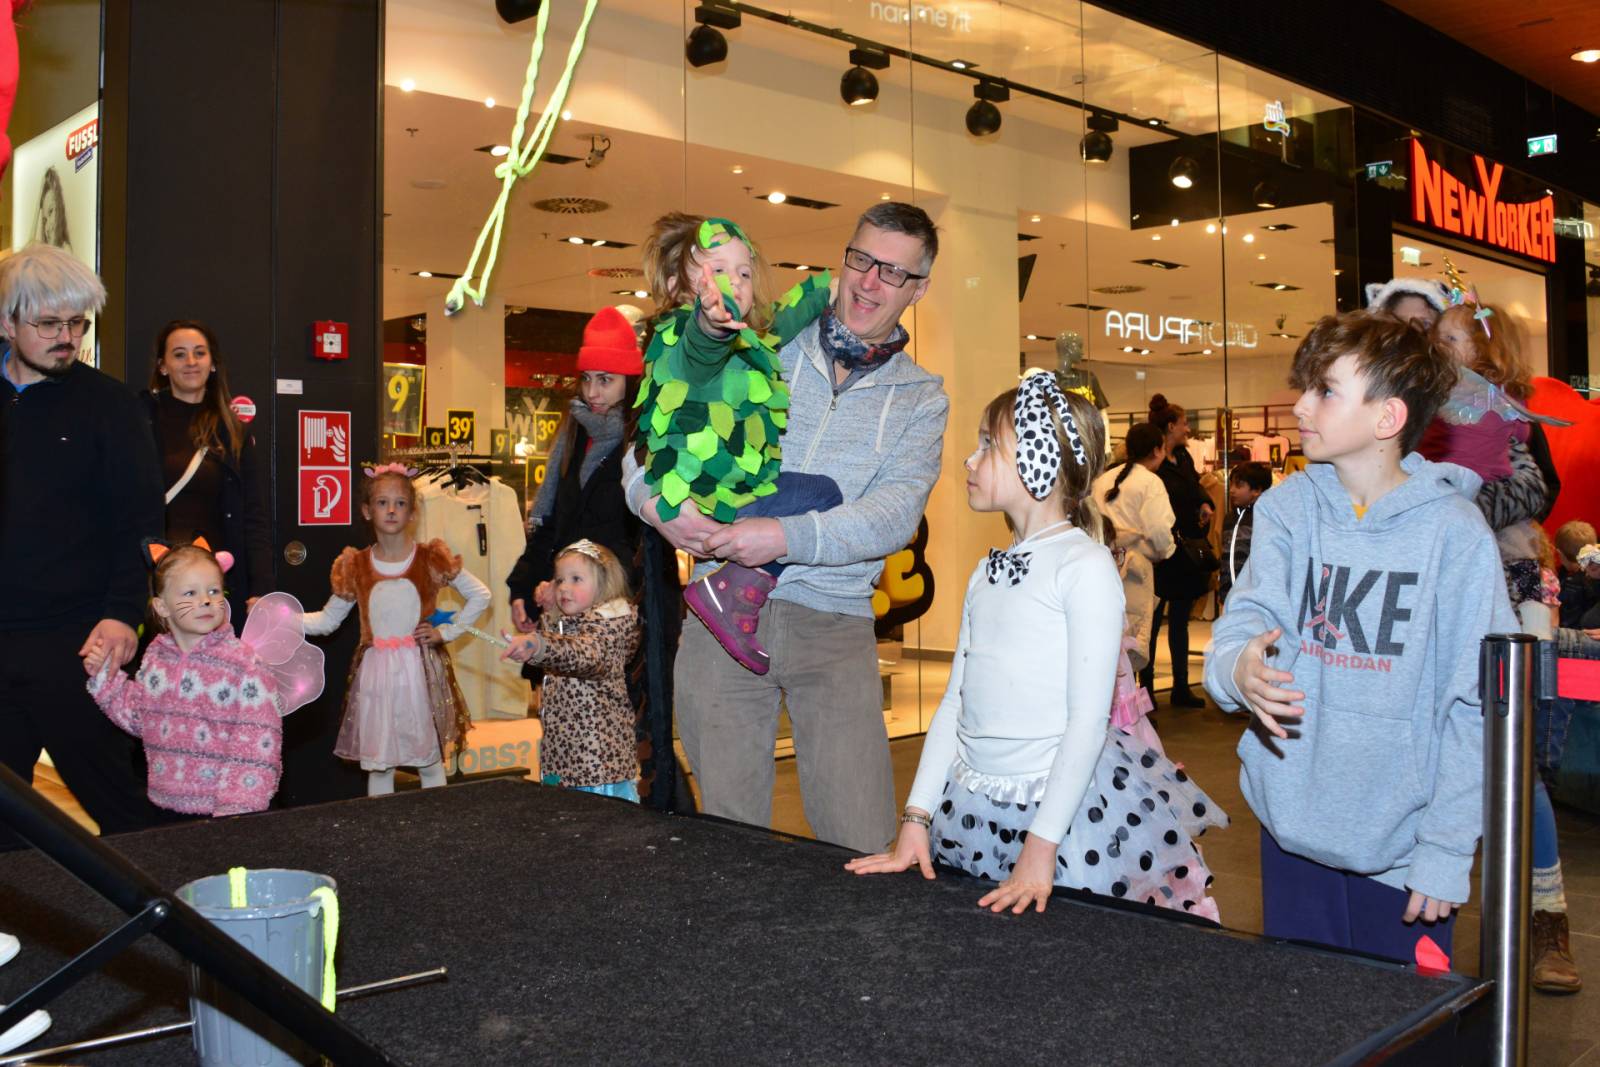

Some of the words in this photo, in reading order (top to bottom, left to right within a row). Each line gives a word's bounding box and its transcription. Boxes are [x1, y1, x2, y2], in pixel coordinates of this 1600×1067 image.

[68, 123, 98, 156] FUSSL
[388, 374, 409, 412] 9
[449, 417, 471, 439] 39
